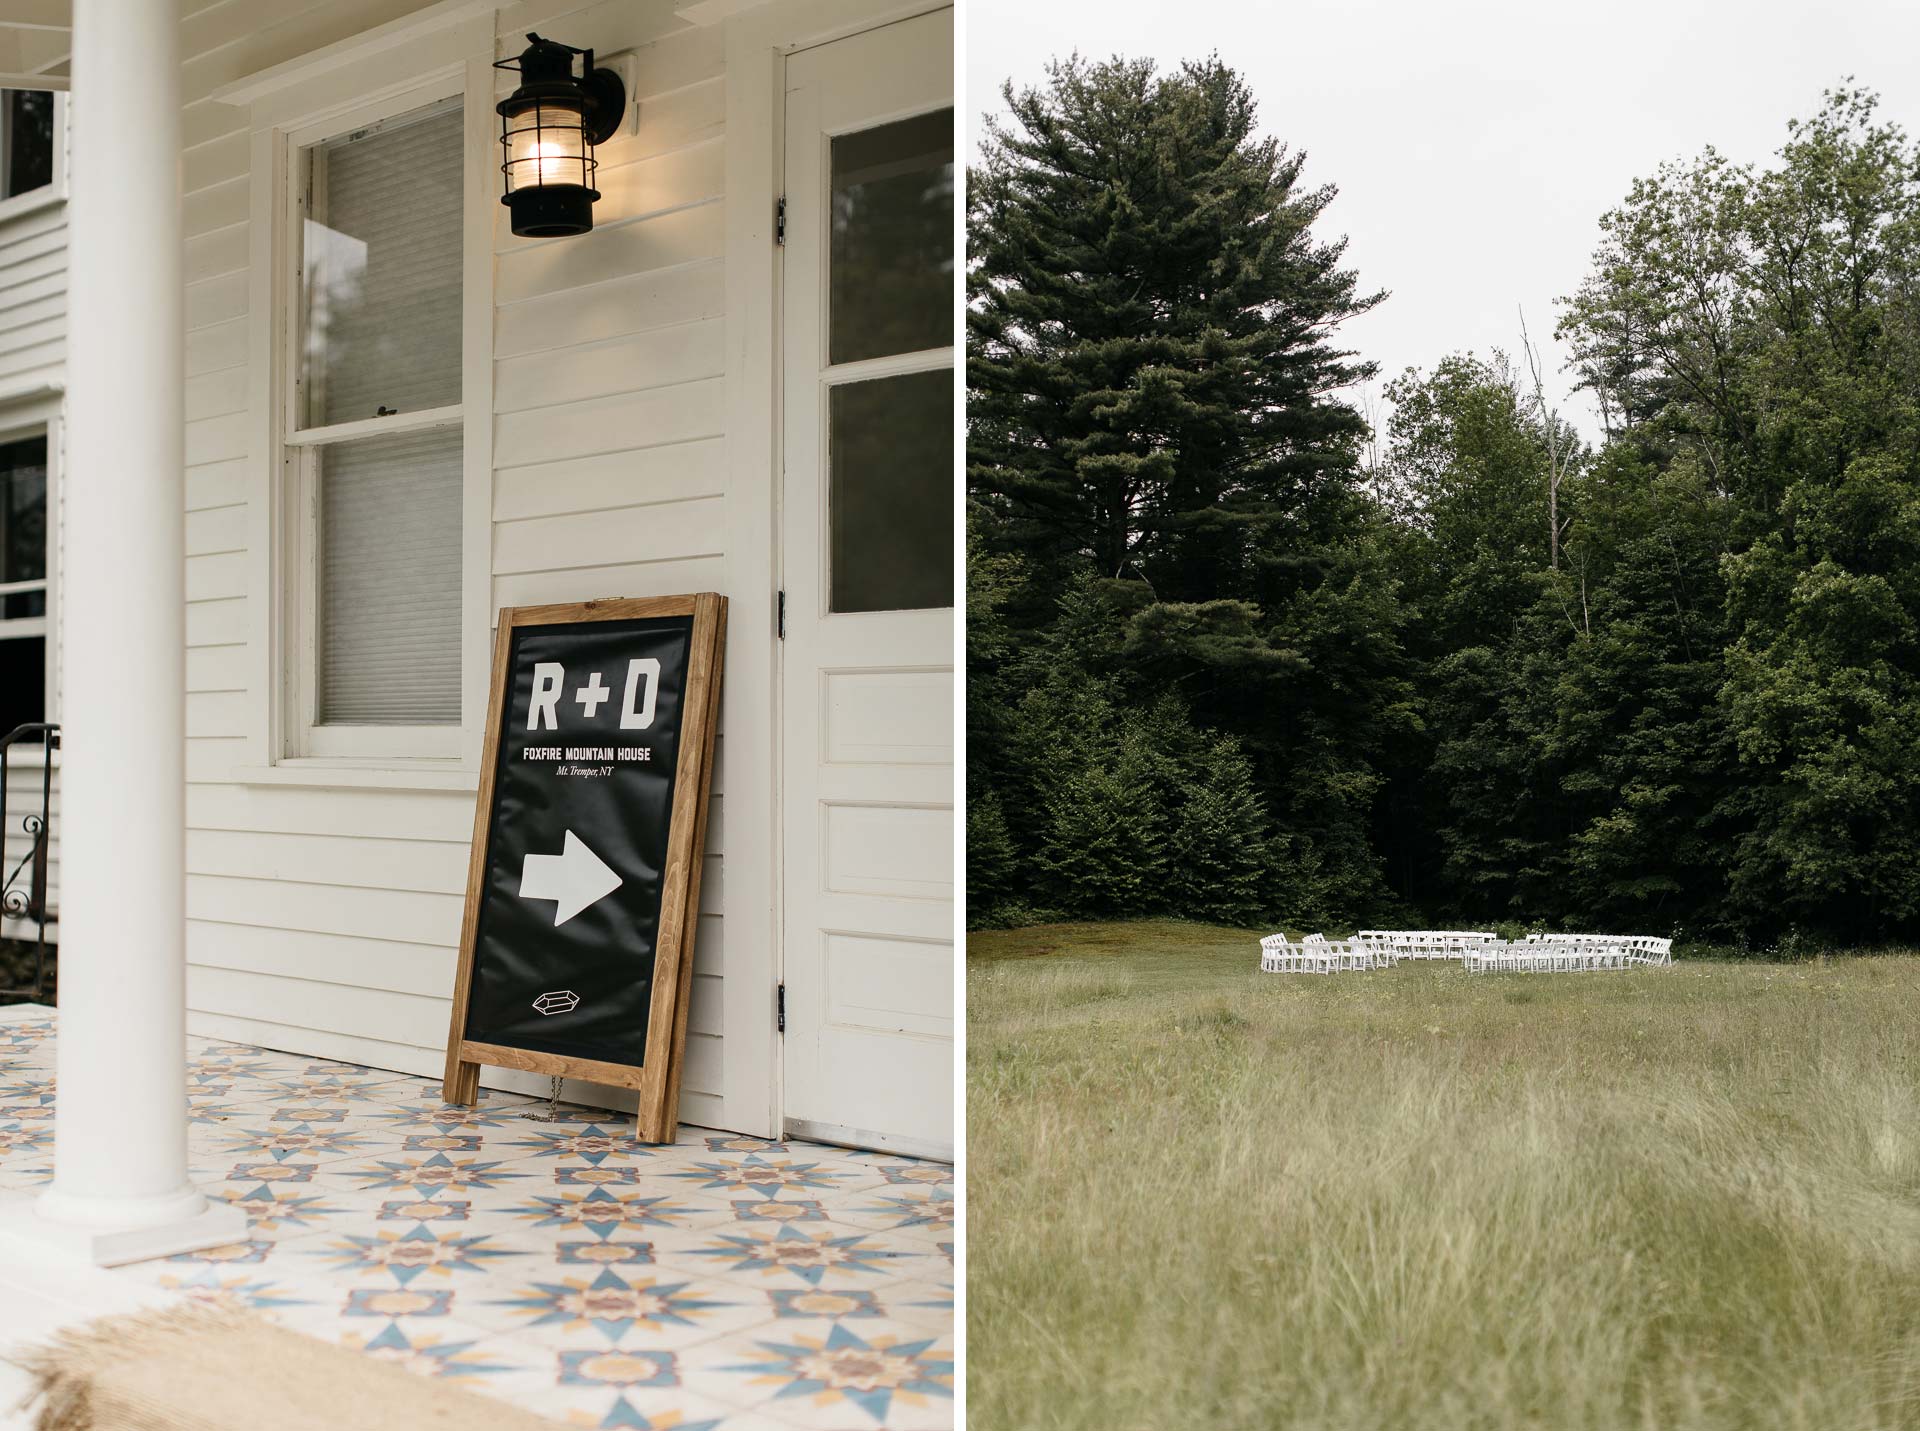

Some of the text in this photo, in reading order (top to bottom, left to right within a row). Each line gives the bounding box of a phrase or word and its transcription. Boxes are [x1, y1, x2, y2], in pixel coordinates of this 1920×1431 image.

[527, 662, 565, 730] R
[619, 658, 661, 730] D
[523, 747, 651, 761] FOXFIRE MOUNTAIN HOUSE
[556, 765, 568, 776] Mt.
[570, 765, 599, 779] Tremper,
